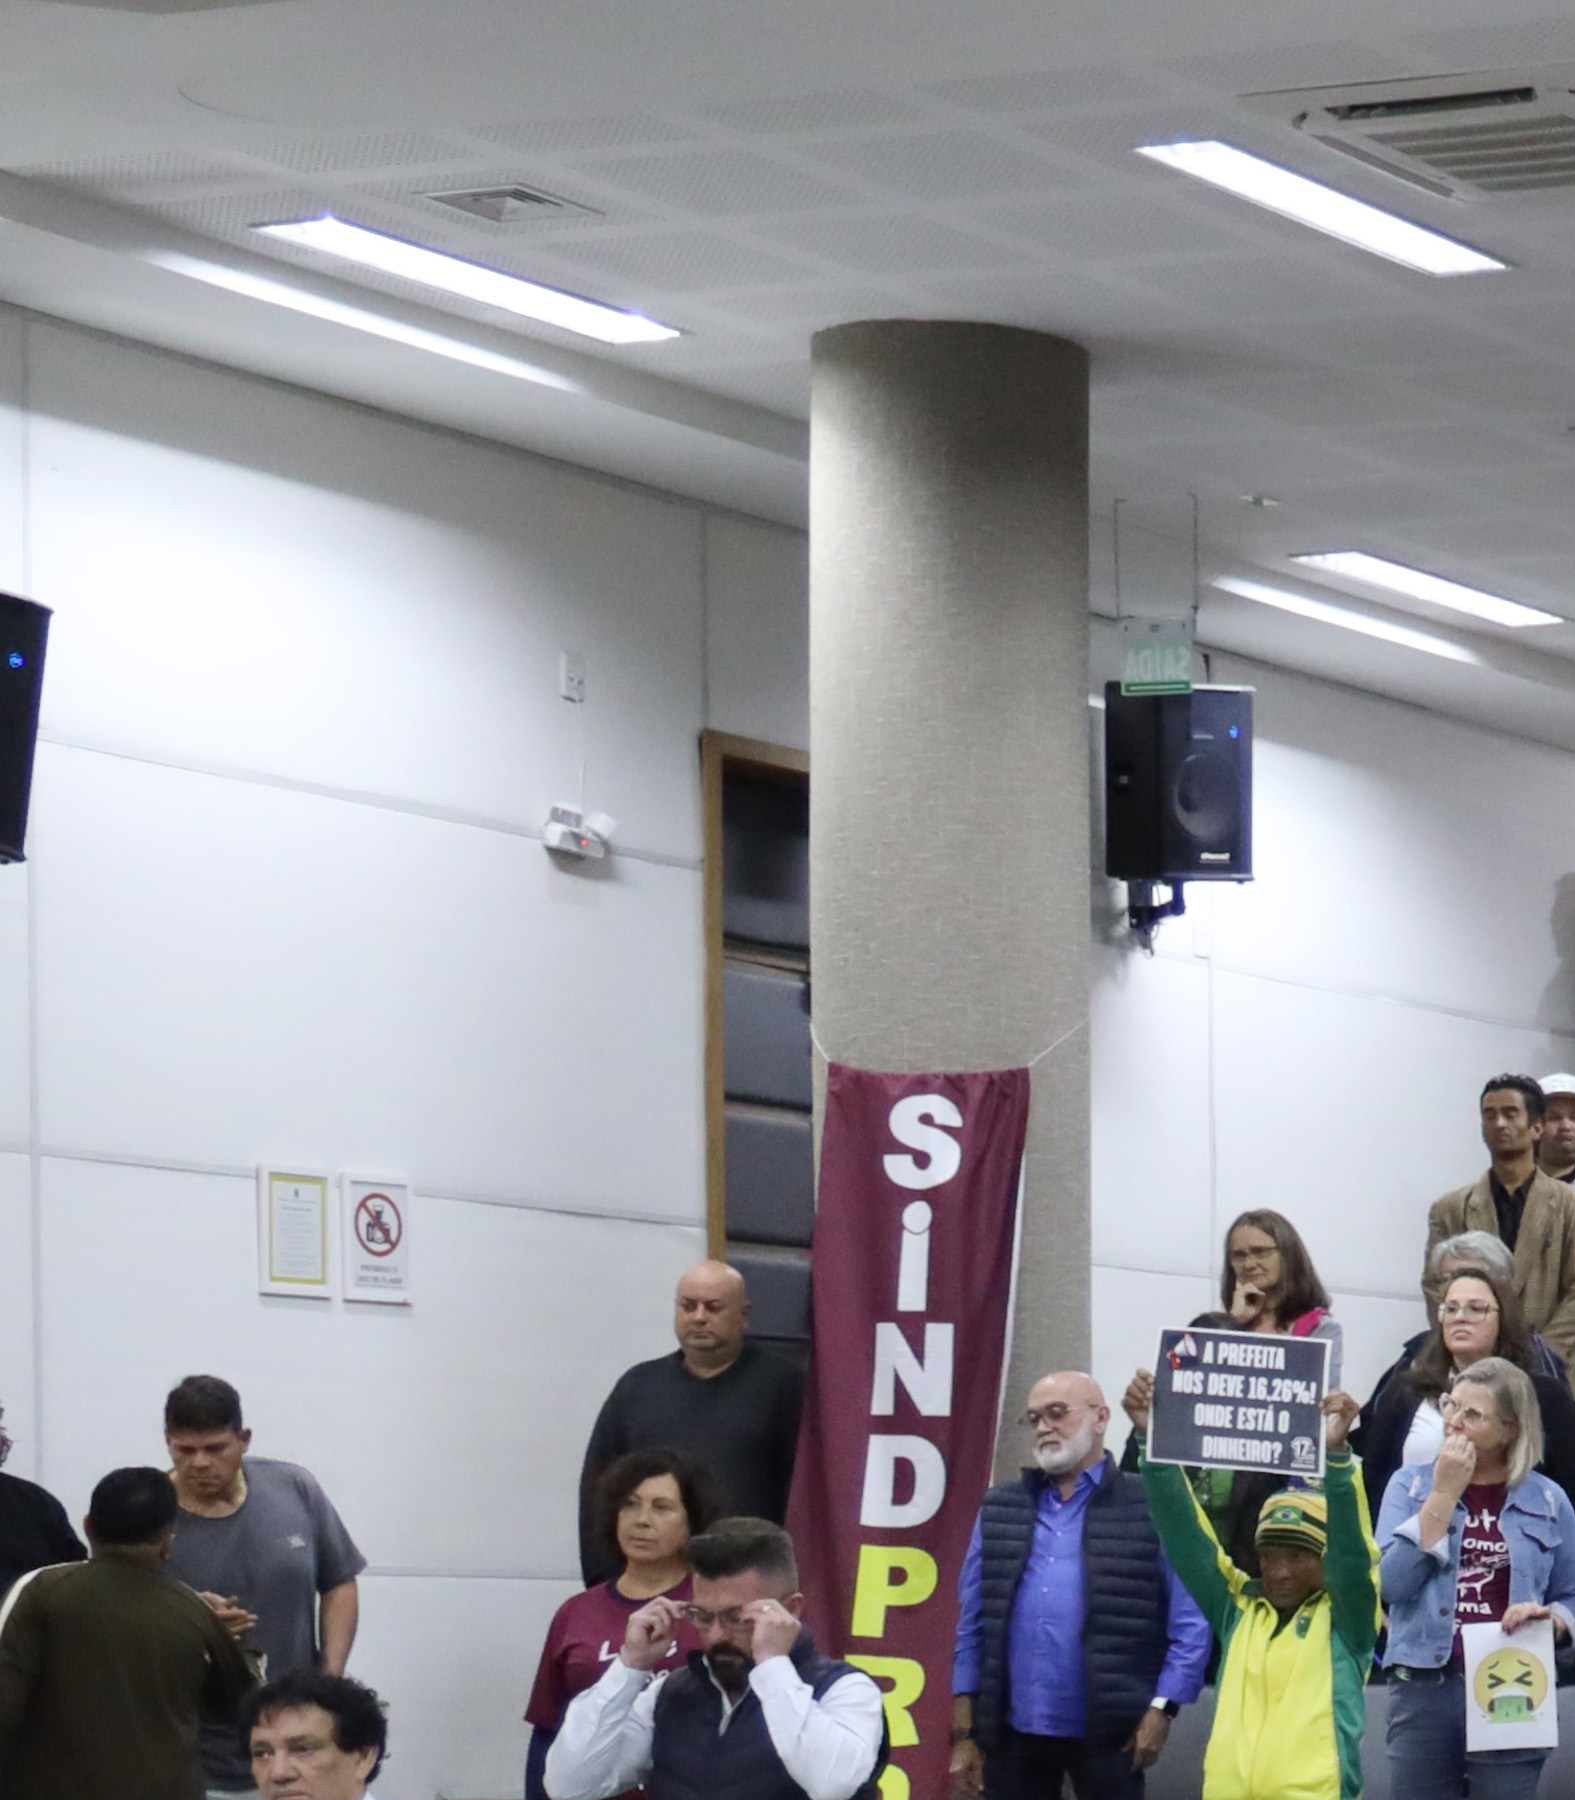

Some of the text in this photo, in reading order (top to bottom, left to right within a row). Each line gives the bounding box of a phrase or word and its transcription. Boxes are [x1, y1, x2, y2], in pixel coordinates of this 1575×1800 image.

[1202, 1340, 1286, 1371] A PREFEITA
[1172, 1369, 1205, 1394] NOS
[1207, 1372, 1245, 1398] DEVE
[1194, 1402, 1291, 1434] ONDE ESTÁ O
[1201, 1435, 1283, 1465] DINHEIRO?
